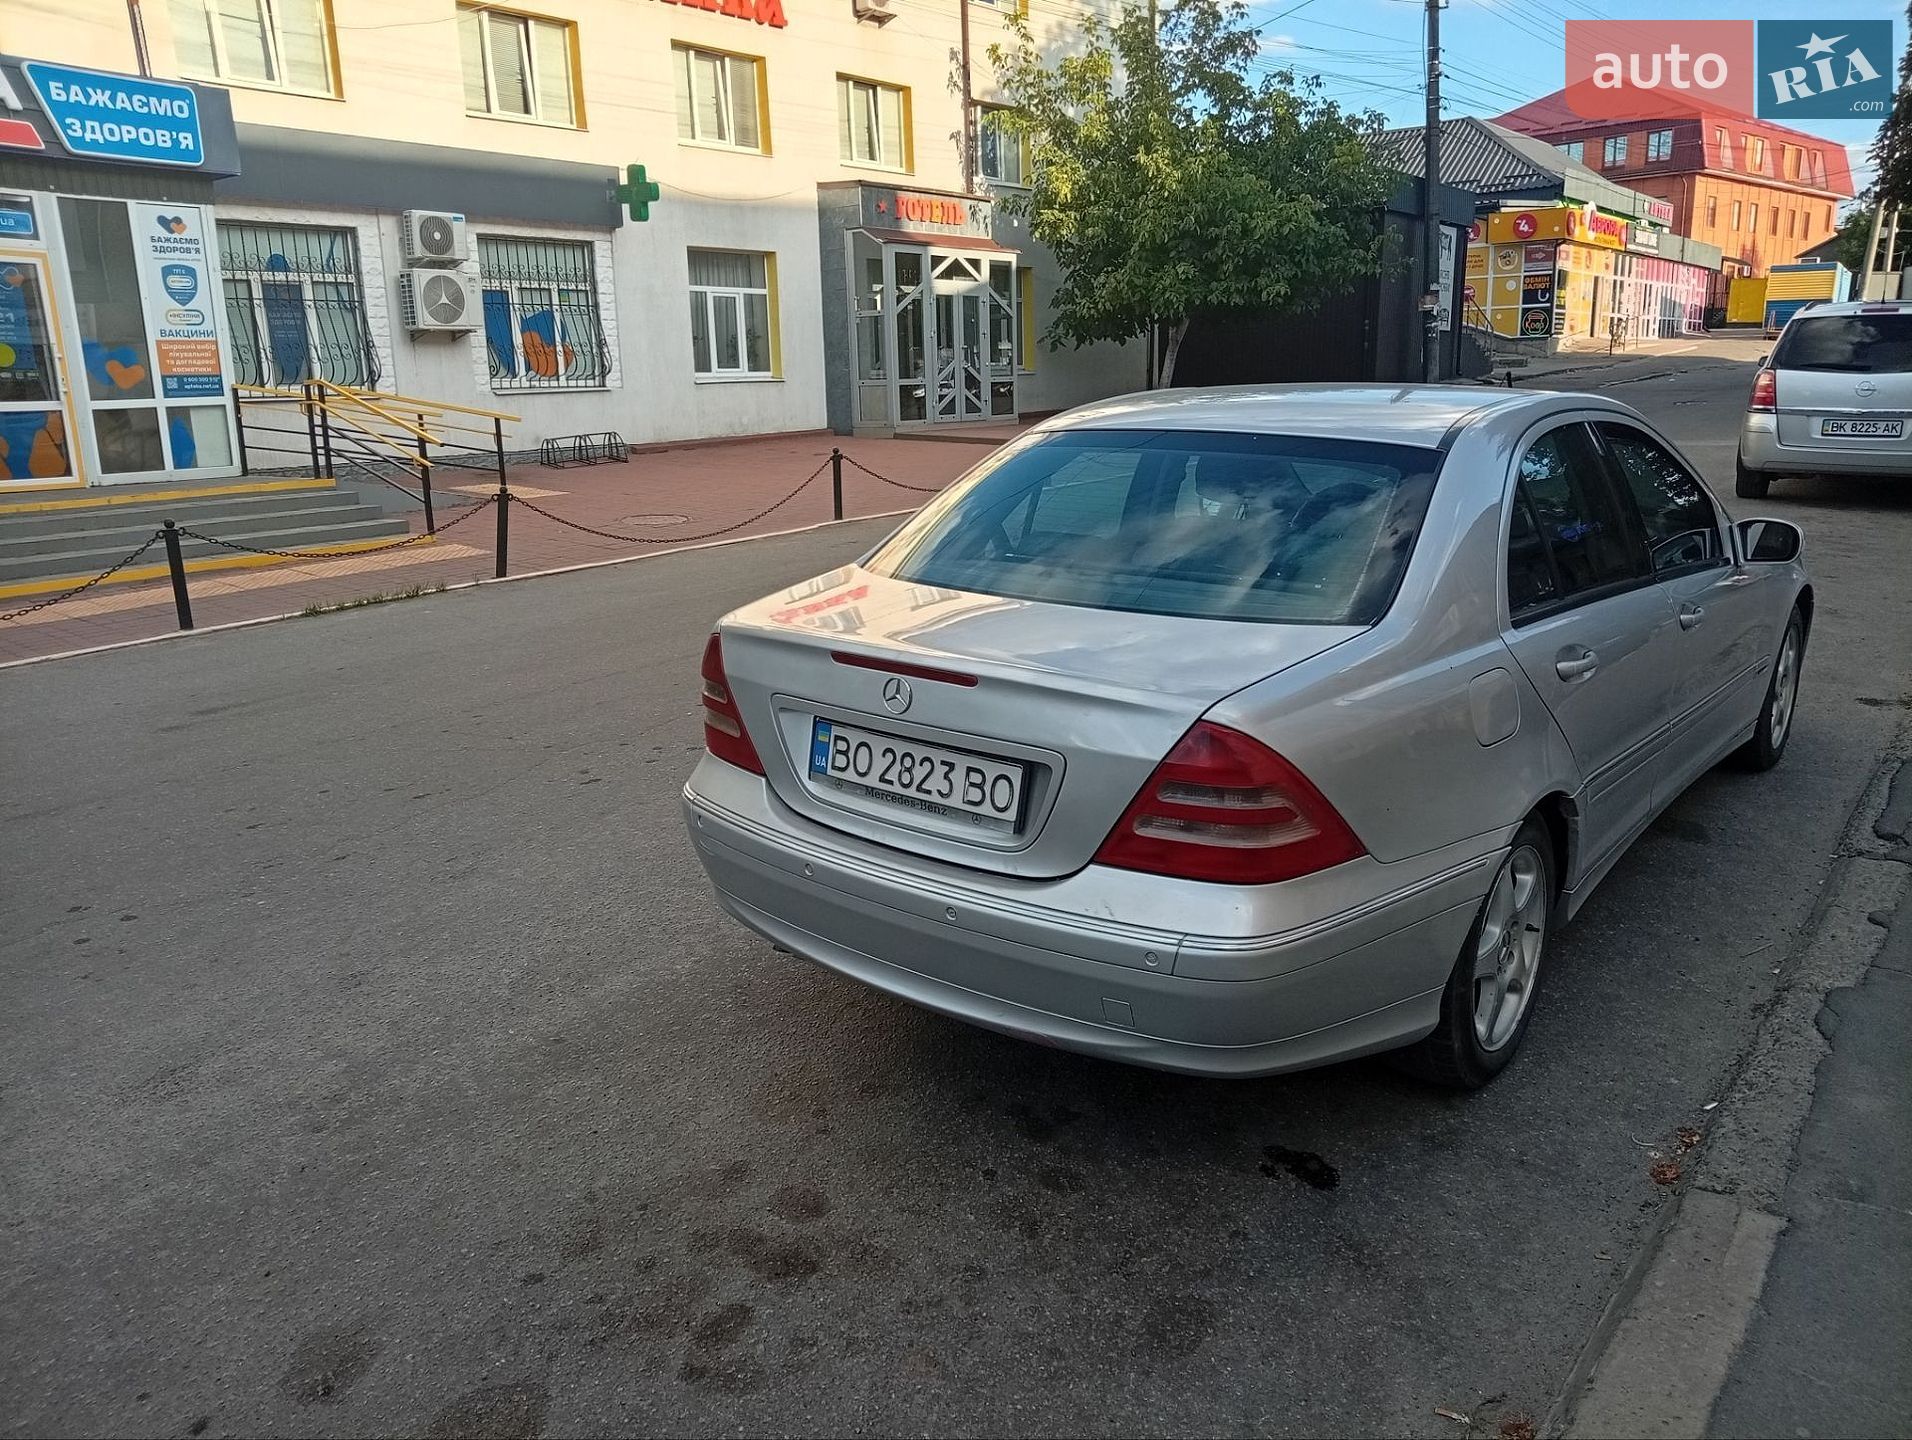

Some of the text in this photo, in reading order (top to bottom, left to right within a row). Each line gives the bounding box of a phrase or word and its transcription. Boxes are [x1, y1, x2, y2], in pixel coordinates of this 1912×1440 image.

[48, 81, 190, 119] БАЖАЄМО
[64, 118, 194, 150] ЗДОРОВ'Я
[895, 196, 964, 225] ГОТЕЛЬ
[150, 235, 200, 246] БАЖАЄМО
[152, 245, 201, 255] ЗДОРОВ'Я
[160, 329, 214, 339] ВАКЦИНИ
[1831, 422, 1900, 434] BK 8225 AK
[814, 754, 827, 769] UA
[831, 734, 1015, 813] BO 2823 BO
[864, 787, 948, 816] Mercedes-Benz
